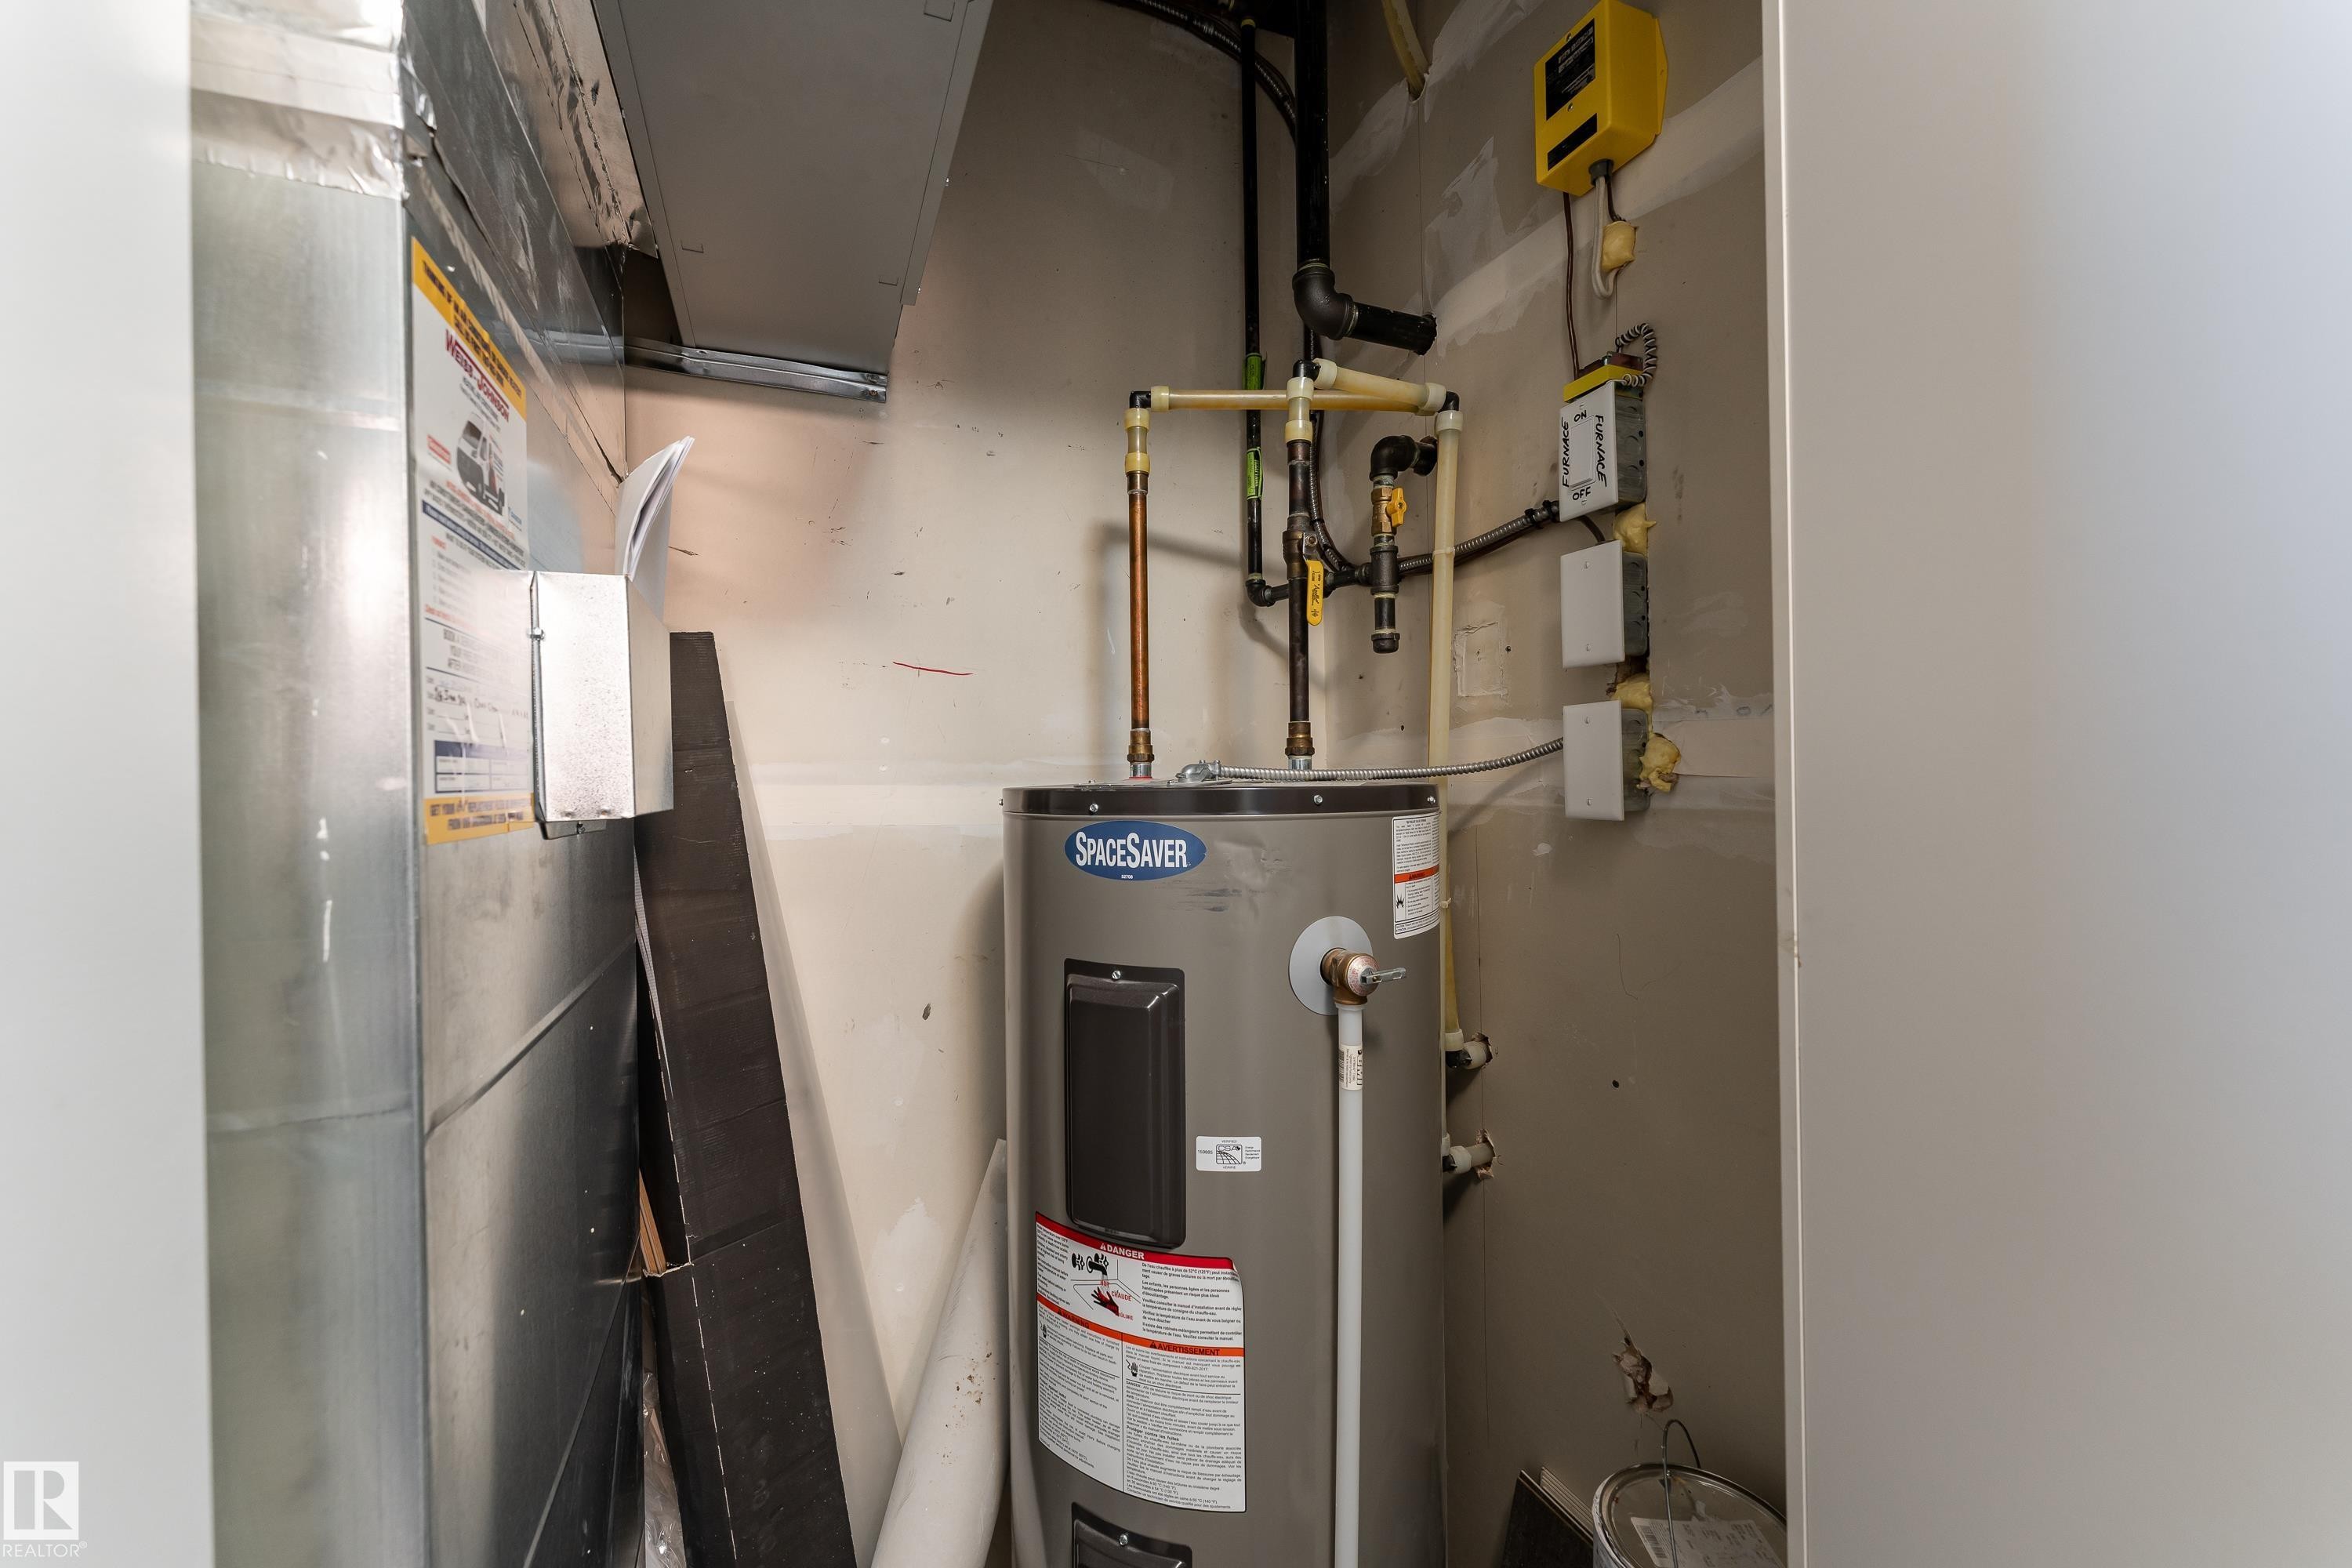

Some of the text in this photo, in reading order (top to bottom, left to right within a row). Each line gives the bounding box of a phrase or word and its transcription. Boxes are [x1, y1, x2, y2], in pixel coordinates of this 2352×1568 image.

[1573, 409, 1588, 423] ON
[1561, 416, 1570, 488] FURNACE
[1595, 414, 1608, 488] FURNACE
[1572, 485, 1592, 501] OFF
[1107, 1243, 1145, 1260] DANGER
[1111, 1291, 1132, 1301] CHAUDE
[1157, 1342, 1220, 1356] AVERTISSEMENT
